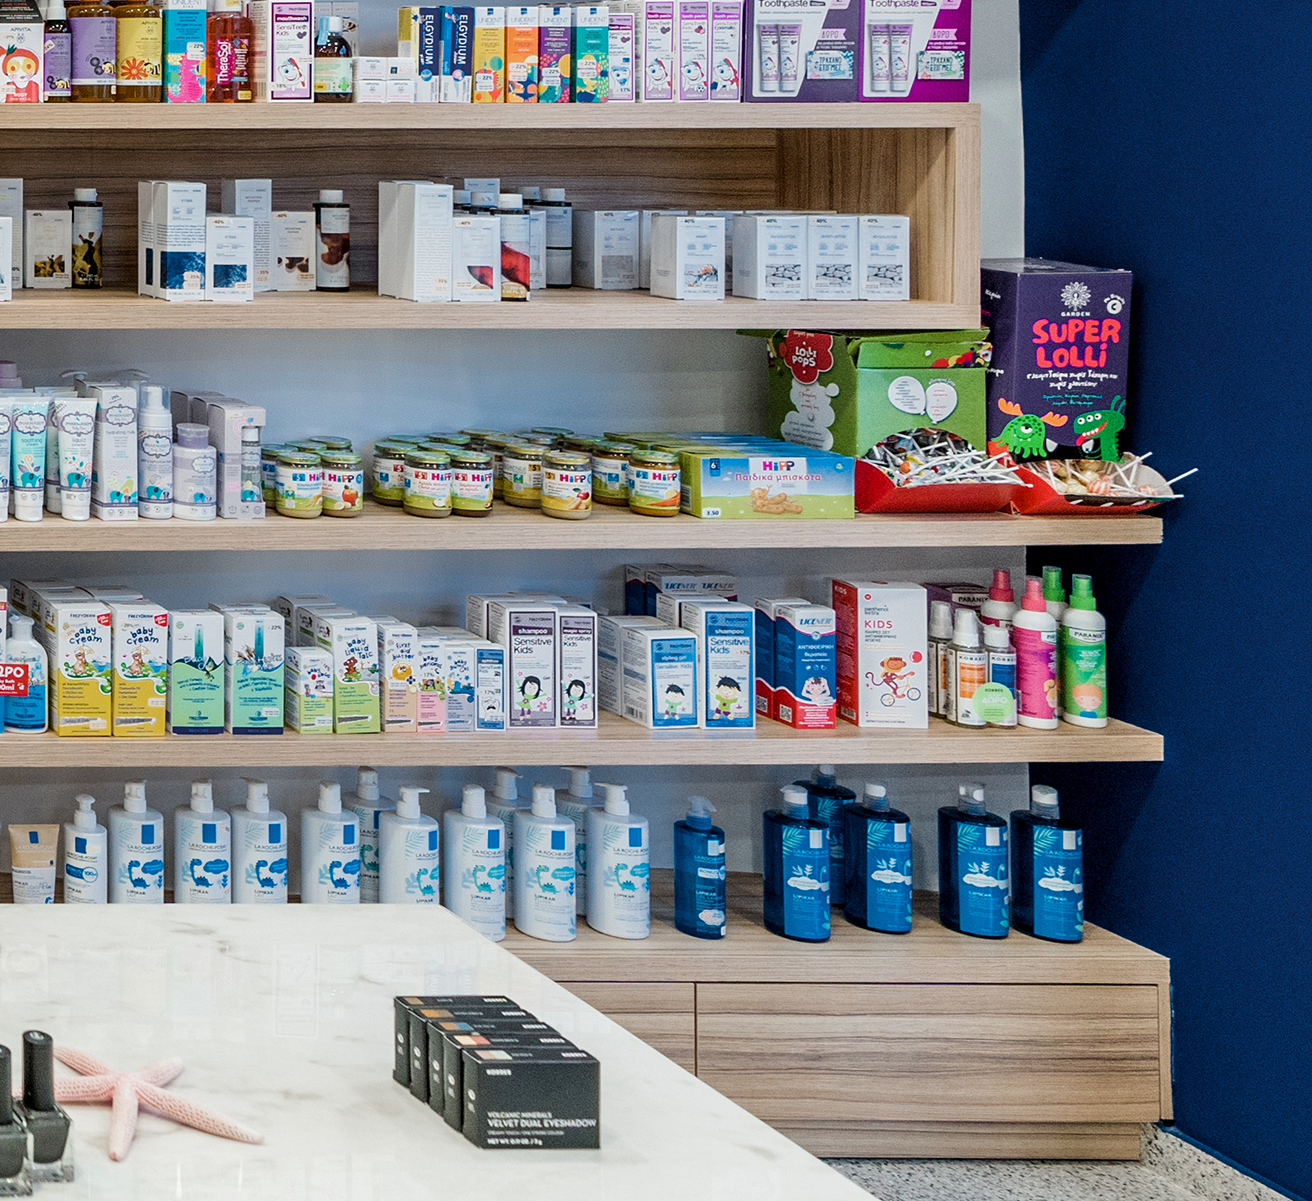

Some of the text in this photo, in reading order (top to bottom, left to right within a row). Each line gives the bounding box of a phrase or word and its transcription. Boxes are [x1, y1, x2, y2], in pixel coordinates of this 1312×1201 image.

[425, 13, 434, 66] ELGYDIUM
[458, 13, 468, 66] ELGYDIUM
[1031, 318, 1122, 345] SUPER
[762, 461, 795, 472] HiPP
[328, 473, 354, 483] HiPP
[560, 473, 587, 483] HiPP
[652, 472, 678, 482] HiPP
[735, 472, 822, 484] Παιδικά μπισκότα
[865, 620, 893, 630] KIDS
[74, 626, 96, 639] baby
[130, 627, 153, 639] baby
[513, 637, 552, 647] Sensitive
[563, 635, 592, 643] Sensitive
[710, 637, 749, 647] Sensitive
[513, 645, 534, 654] Kids
[710, 646, 730, 655] Kids
[487, 1118, 597, 1128] VELVET DUAL EYESHADOW
